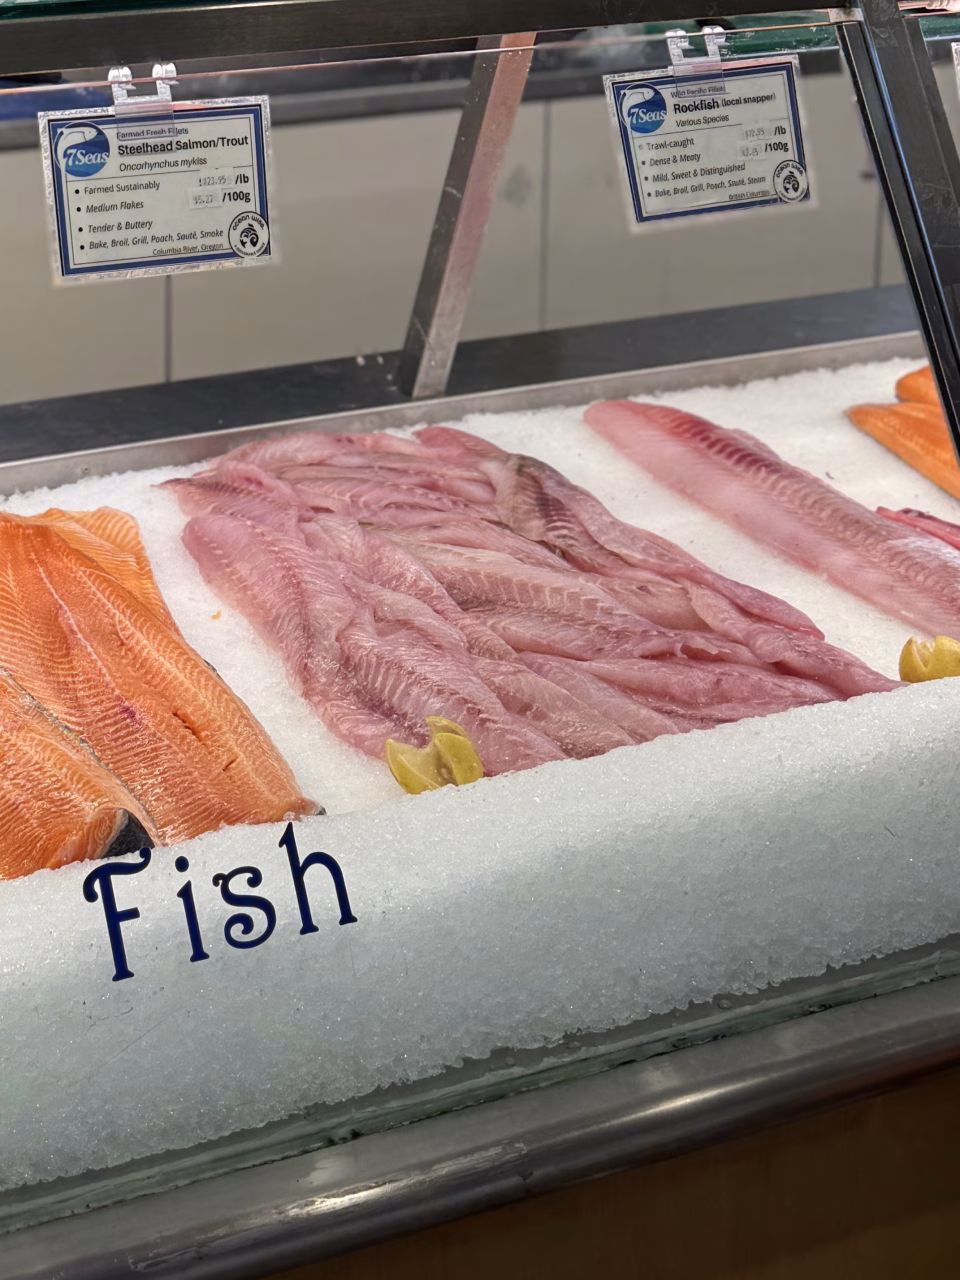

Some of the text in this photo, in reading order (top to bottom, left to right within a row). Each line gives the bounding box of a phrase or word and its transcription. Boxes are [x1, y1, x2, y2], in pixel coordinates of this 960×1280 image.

[673, 91, 776, 115] Rockfish (local snapper)
[630, 107, 667, 124] 7Seas
[675, 113, 730, 128] Various Species
[773, 125, 787, 136] /lb
[118, 135, 249, 156] Steelhead Salmon/Trout
[646, 137, 695, 151] Trawl-caught
[764, 141, 790, 153] /100g
[66, 147, 110, 167] 7Seas
[119, 156, 208, 172] Oncorhynchus mykiss
[649, 152, 701, 167] Dense & Meaty
[234, 173, 250, 185] /lb
[652, 161, 746, 183] Mild, Sweet & Distinguished
[84, 180, 161, 195] Farmed Sustainably
[690, 183, 705, 193] Grill,
[222, 190, 251, 203] /100g
[86, 200, 145, 213] Medium Flakes
[88, 220, 153, 234] Tender & Buttery
[89, 228, 224, 250] Bake, Broil, Grill, Poach, Sauté, Smoke
[152, 245, 182, 257] Columbia
[182, 243, 200, 254] River,
[201, 241, 224, 252] Oregon
[83, 821, 358, 982] Fish
